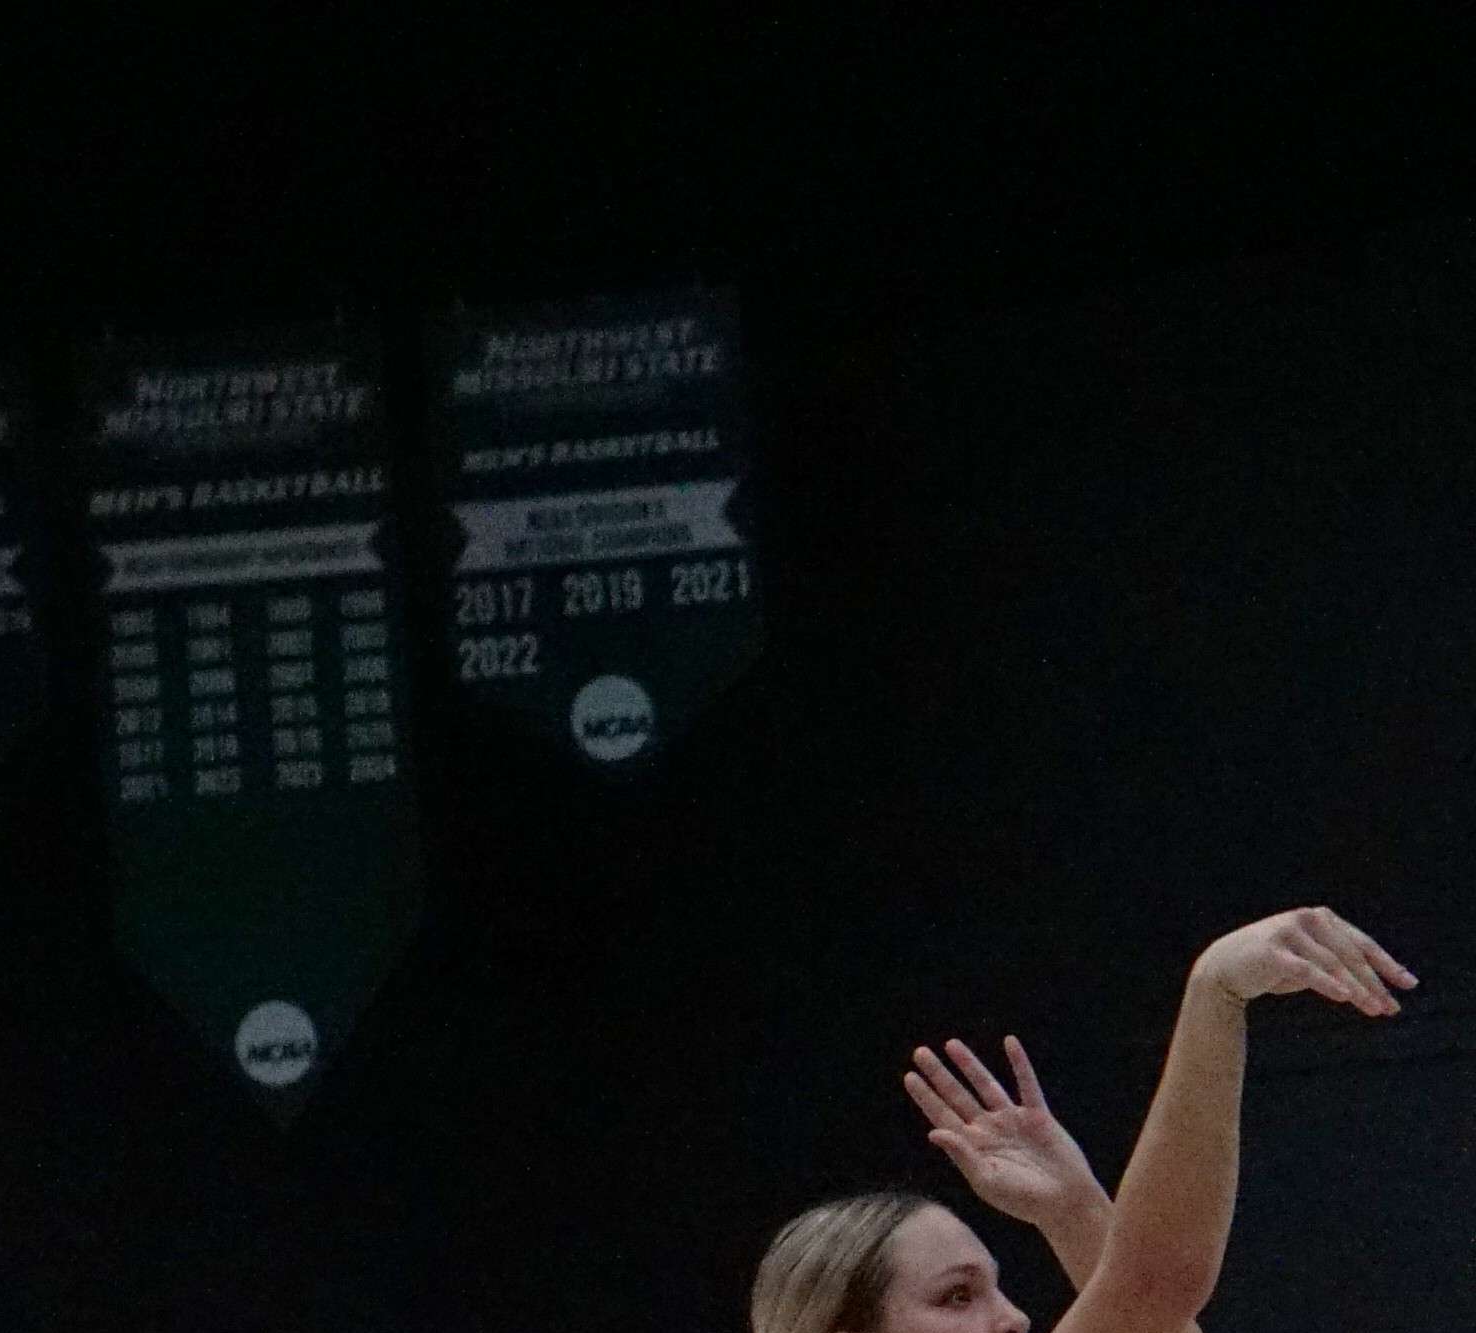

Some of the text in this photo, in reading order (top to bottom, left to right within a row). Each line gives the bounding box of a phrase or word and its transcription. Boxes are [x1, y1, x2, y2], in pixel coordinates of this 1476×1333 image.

[456, 557, 752, 627] 2017 2019 2021
[458, 630, 542, 682] 2022
